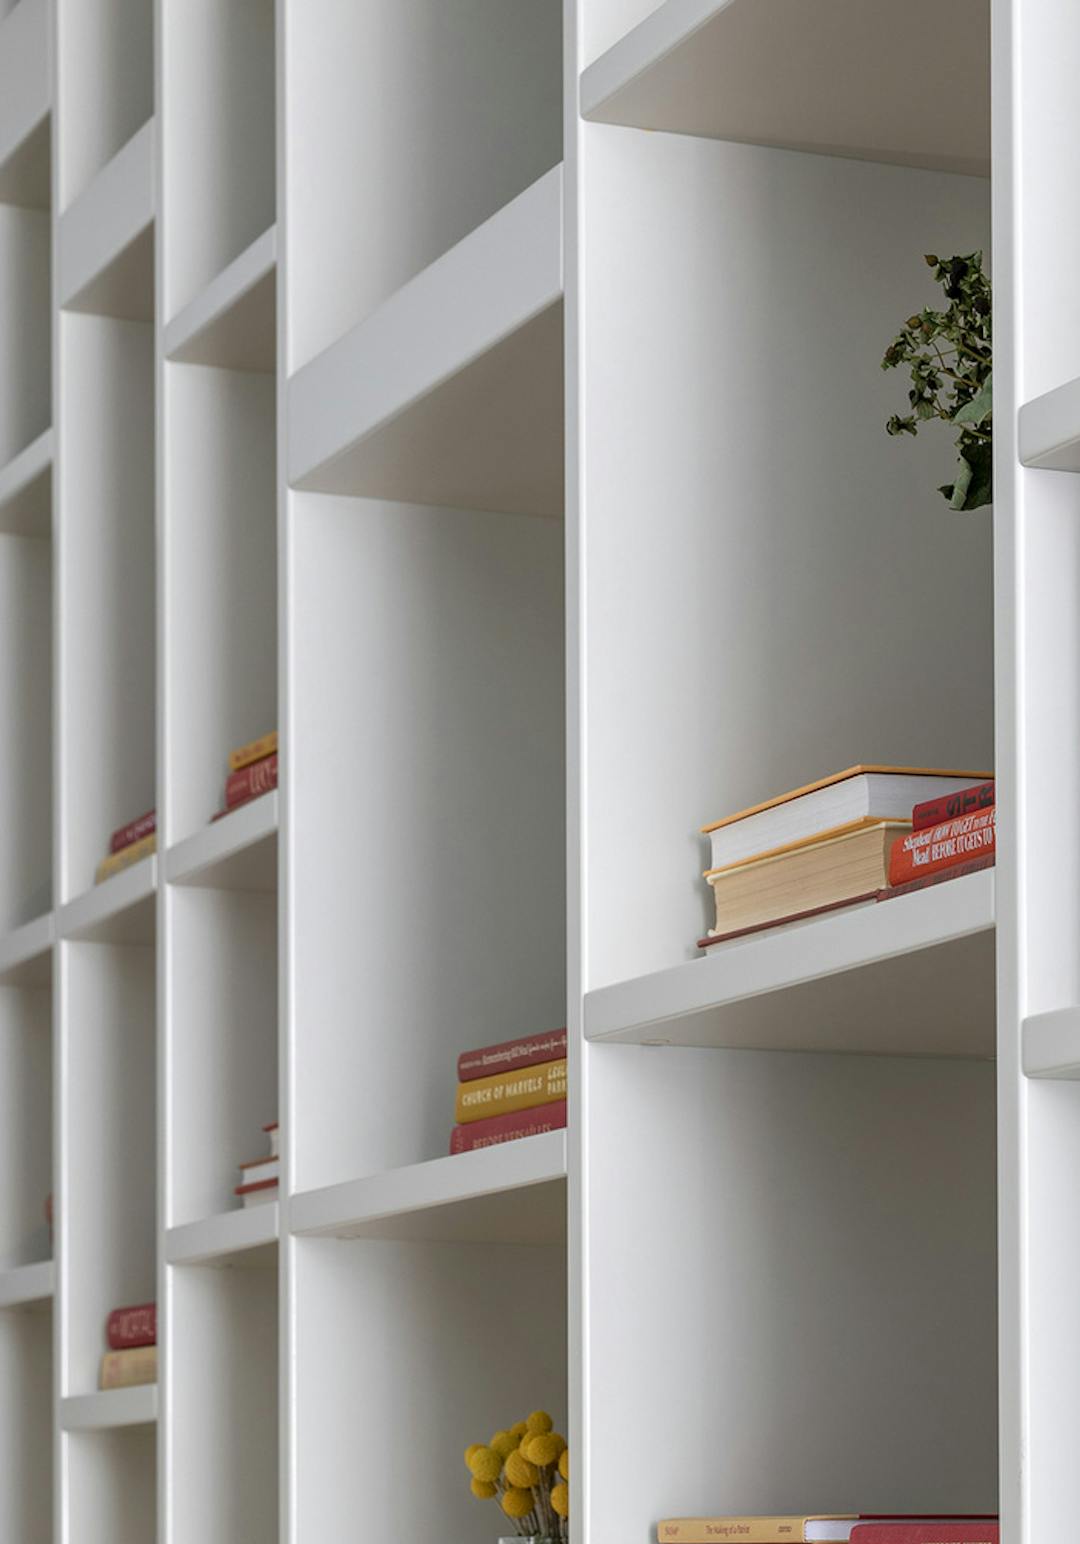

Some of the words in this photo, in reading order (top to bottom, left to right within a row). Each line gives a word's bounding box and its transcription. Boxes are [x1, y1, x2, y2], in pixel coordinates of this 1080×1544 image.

[462, 1088, 491, 1106] CHURCH
[493, 1085, 503, 1100] OF
[505, 1077, 543, 1098] MARVELS
